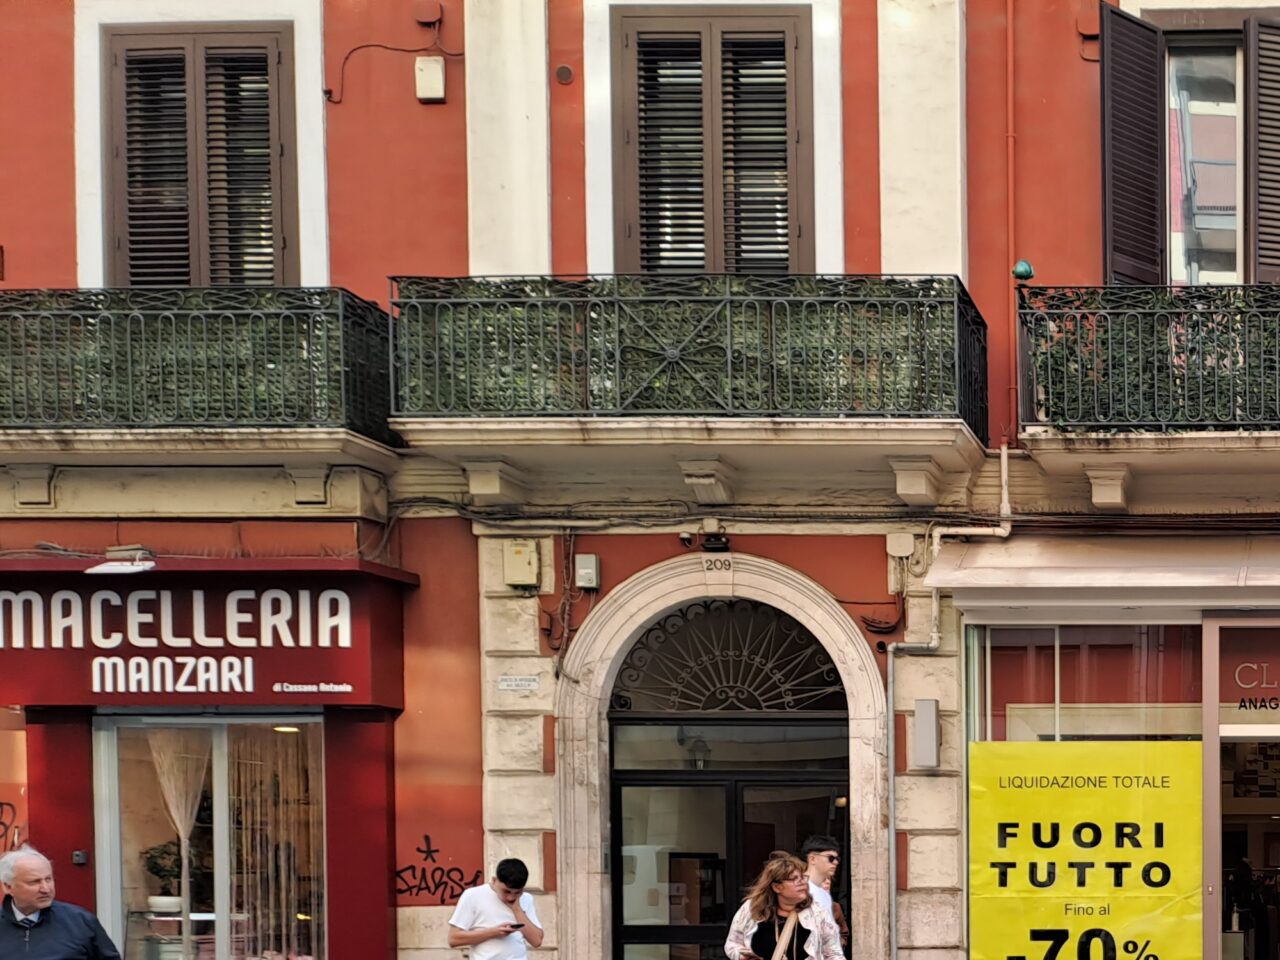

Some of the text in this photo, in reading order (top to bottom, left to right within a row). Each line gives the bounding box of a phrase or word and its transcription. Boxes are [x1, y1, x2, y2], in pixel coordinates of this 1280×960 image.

[705, 558, 731, 571] 209
[0, 588, 352, 649] MACELLERIA
[91, 655, 254, 693] MANZARI
[998, 775, 1171, 789] LIQUIDAZIONE TOTALE
[997, 822, 1164, 849] FUORI
[990, 861, 1172, 888] TUTTO
[1064, 903, 1111, 916] Fino al
